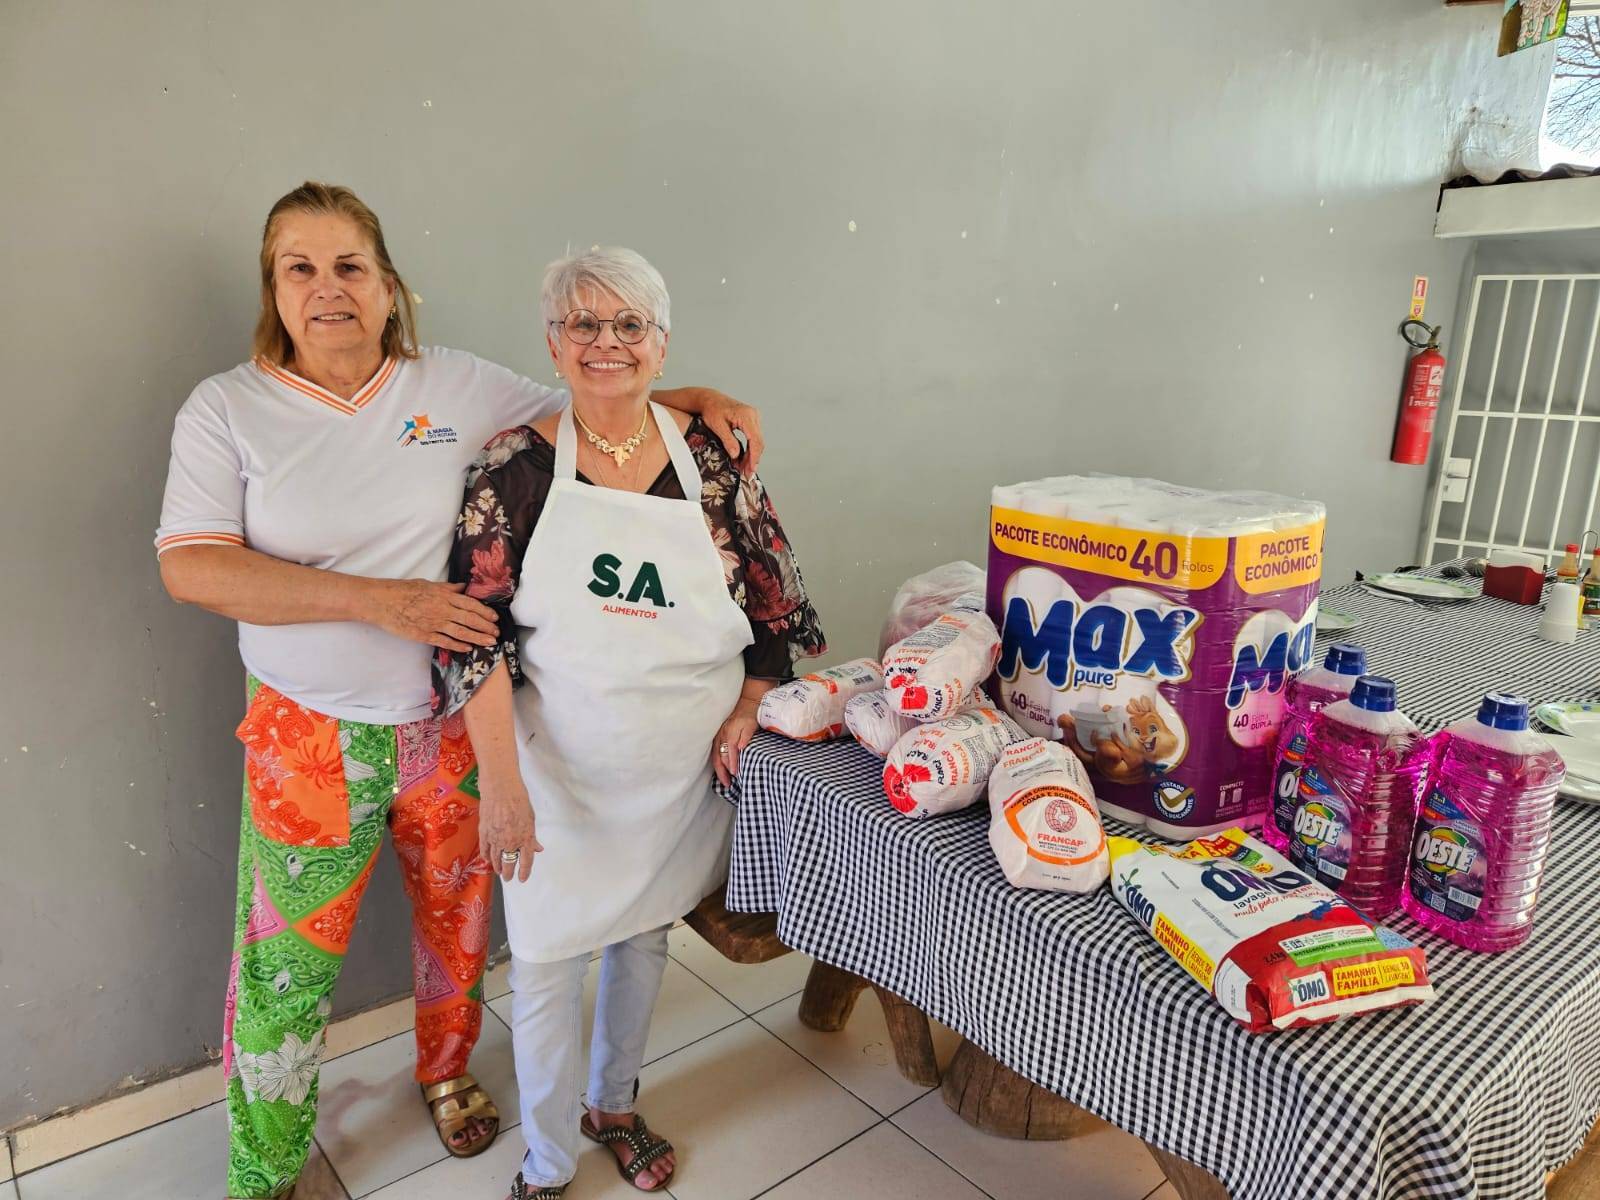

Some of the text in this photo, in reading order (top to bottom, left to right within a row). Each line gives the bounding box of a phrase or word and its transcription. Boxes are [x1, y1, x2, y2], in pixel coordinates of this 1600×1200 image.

[995, 522, 1179, 580] PACOTE ECONÔMICO 40
[1260, 536, 1310, 558] PACOTE
[1245, 554, 1318, 582] ECONÔMICO
[587, 553, 675, 608] S.A.
[602, 604, 657, 619] ALIMENTOS
[1073, 669, 1114, 687] pure
[1010, 690, 1027, 711] 40
[1029, 711, 1055, 728] DUPLA
[1233, 714, 1249, 728] 40
[1250, 720, 1272, 730] DUPLA
[1160, 781, 1185, 792] TESTADO
[1294, 804, 1344, 846] OESTE
[1037, 833, 1084, 847] FRANCAP
[1415, 831, 1478, 874] OESTE
[1126, 886, 1155, 927] OMO
[1158, 917, 1189, 950] TAMANHO
[1335, 966, 1376, 981] TAMANHO
[1337, 977, 1380, 991] FAMÍLIA
[1299, 977, 1327, 1001] OMO
